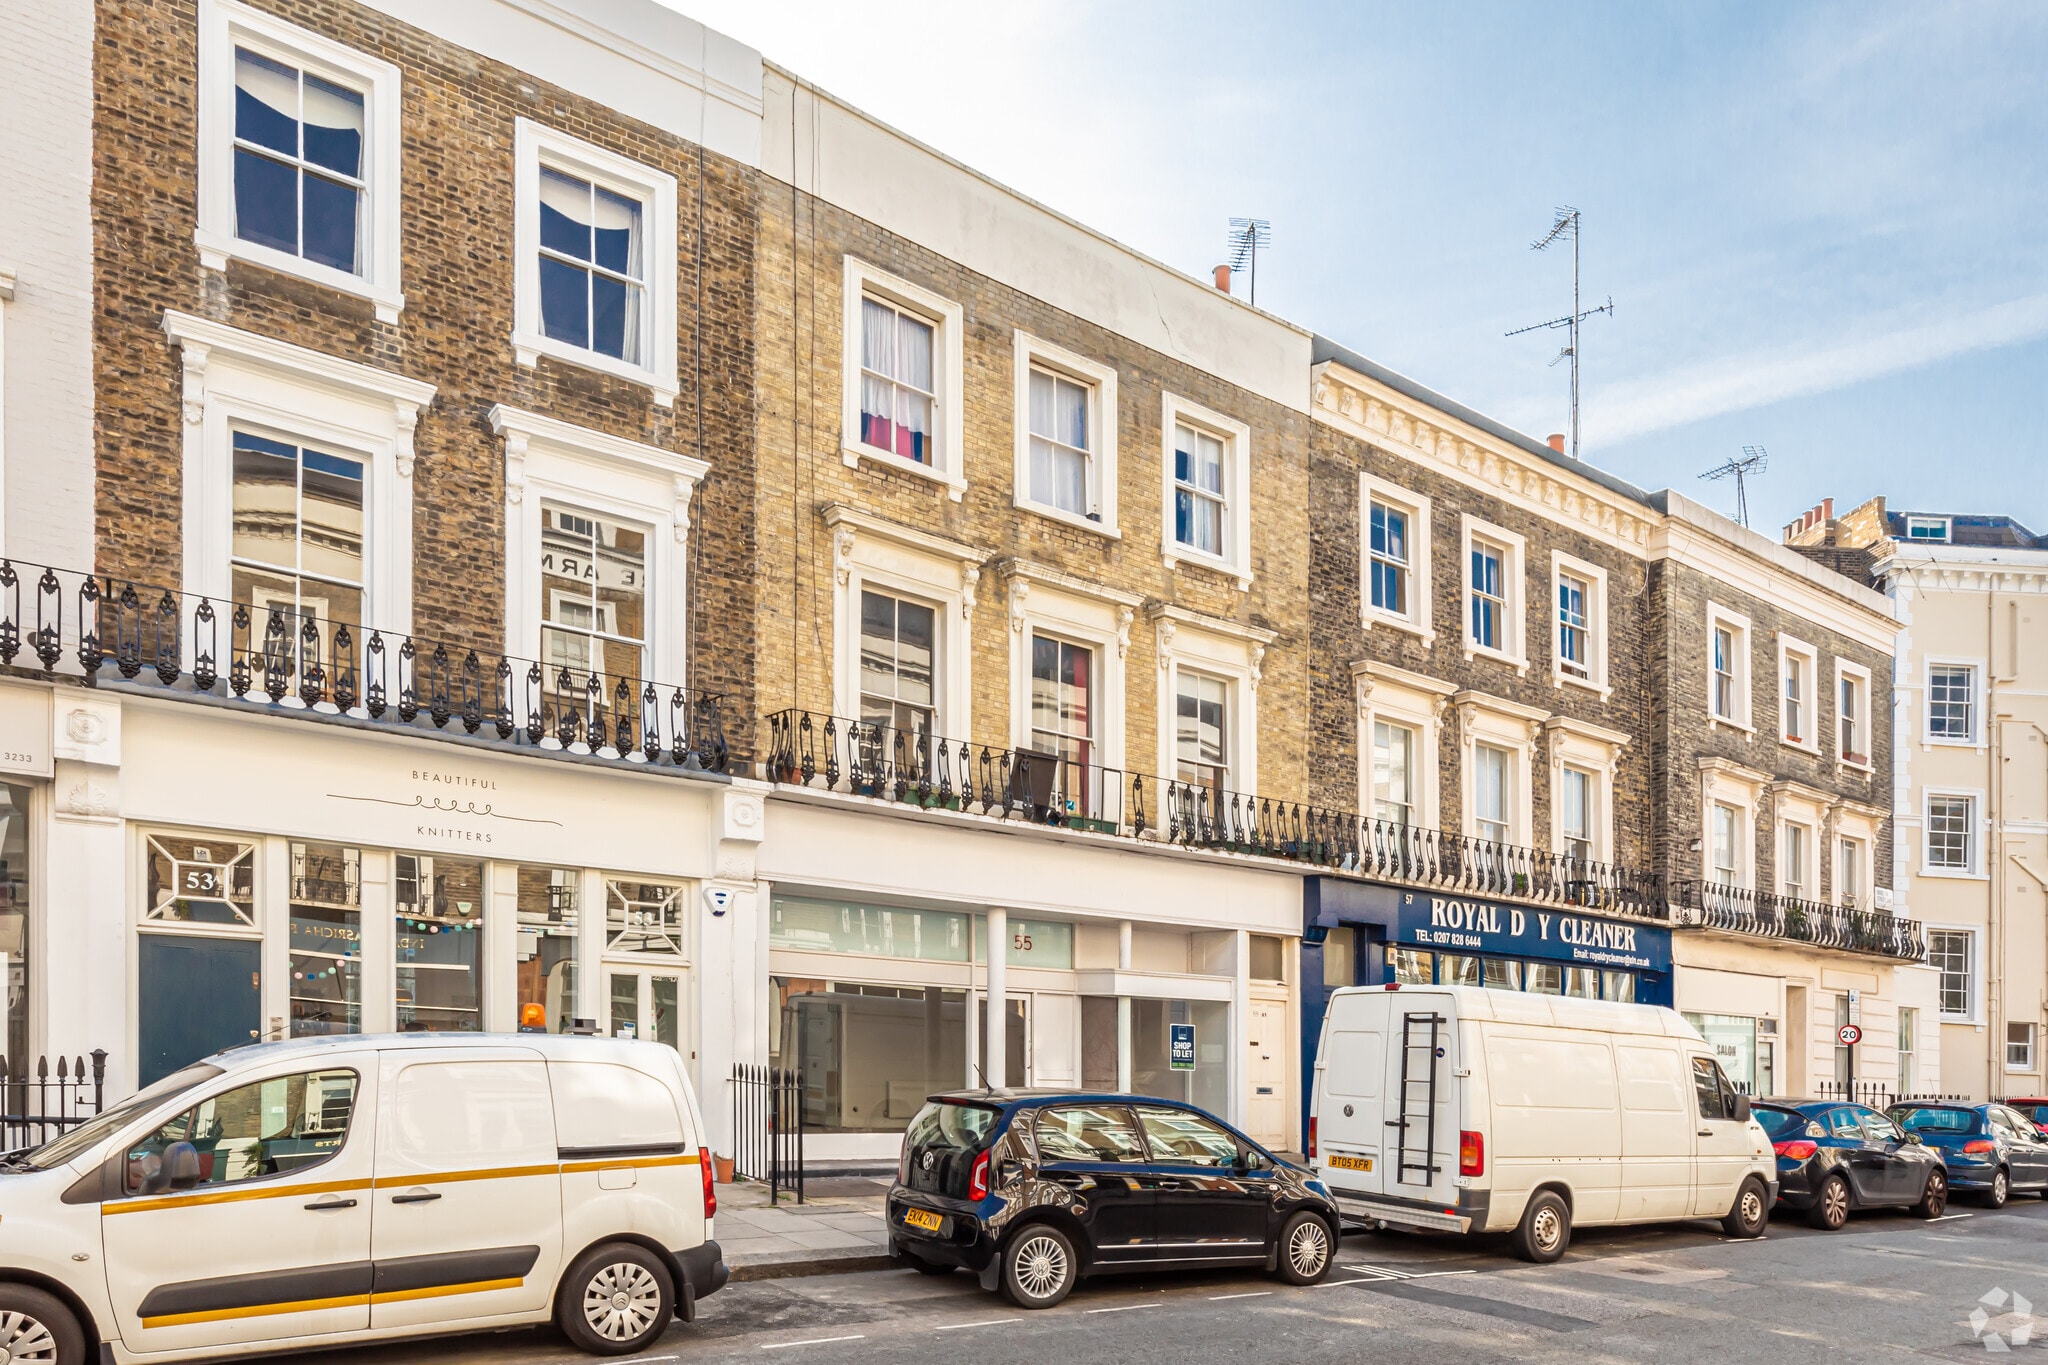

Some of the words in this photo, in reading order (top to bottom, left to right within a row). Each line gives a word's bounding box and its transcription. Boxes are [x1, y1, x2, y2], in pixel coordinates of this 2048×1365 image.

[4, 752, 32, 763] 3233
[412, 770, 497, 791] BEAUTIFUL
[417, 826, 492, 843] KNITTERS
[1405, 894, 1414, 905] 57
[1431, 898, 1502, 934] ROYAL
[1560, 917, 1636, 952] CLEANER
[1014, 935, 1033, 951] 55
[1415, 928, 1432, 943] TEL:
[1433, 931, 1450, 945] 0207
[1451, 933, 1463, 946] 828
[1465, 935, 1481, 947] 6444
[1842, 1030, 1856, 1039] 20
[1173, 1041, 1192, 1050] SHOP
[1716, 1044, 1736, 1056] SALON
[1172, 1049, 1181, 1058] TO
[1182, 1050, 1193, 1058] LET
[1331, 1156, 1352, 1167] BT05
[1353, 1158, 1369, 1170] XFR
